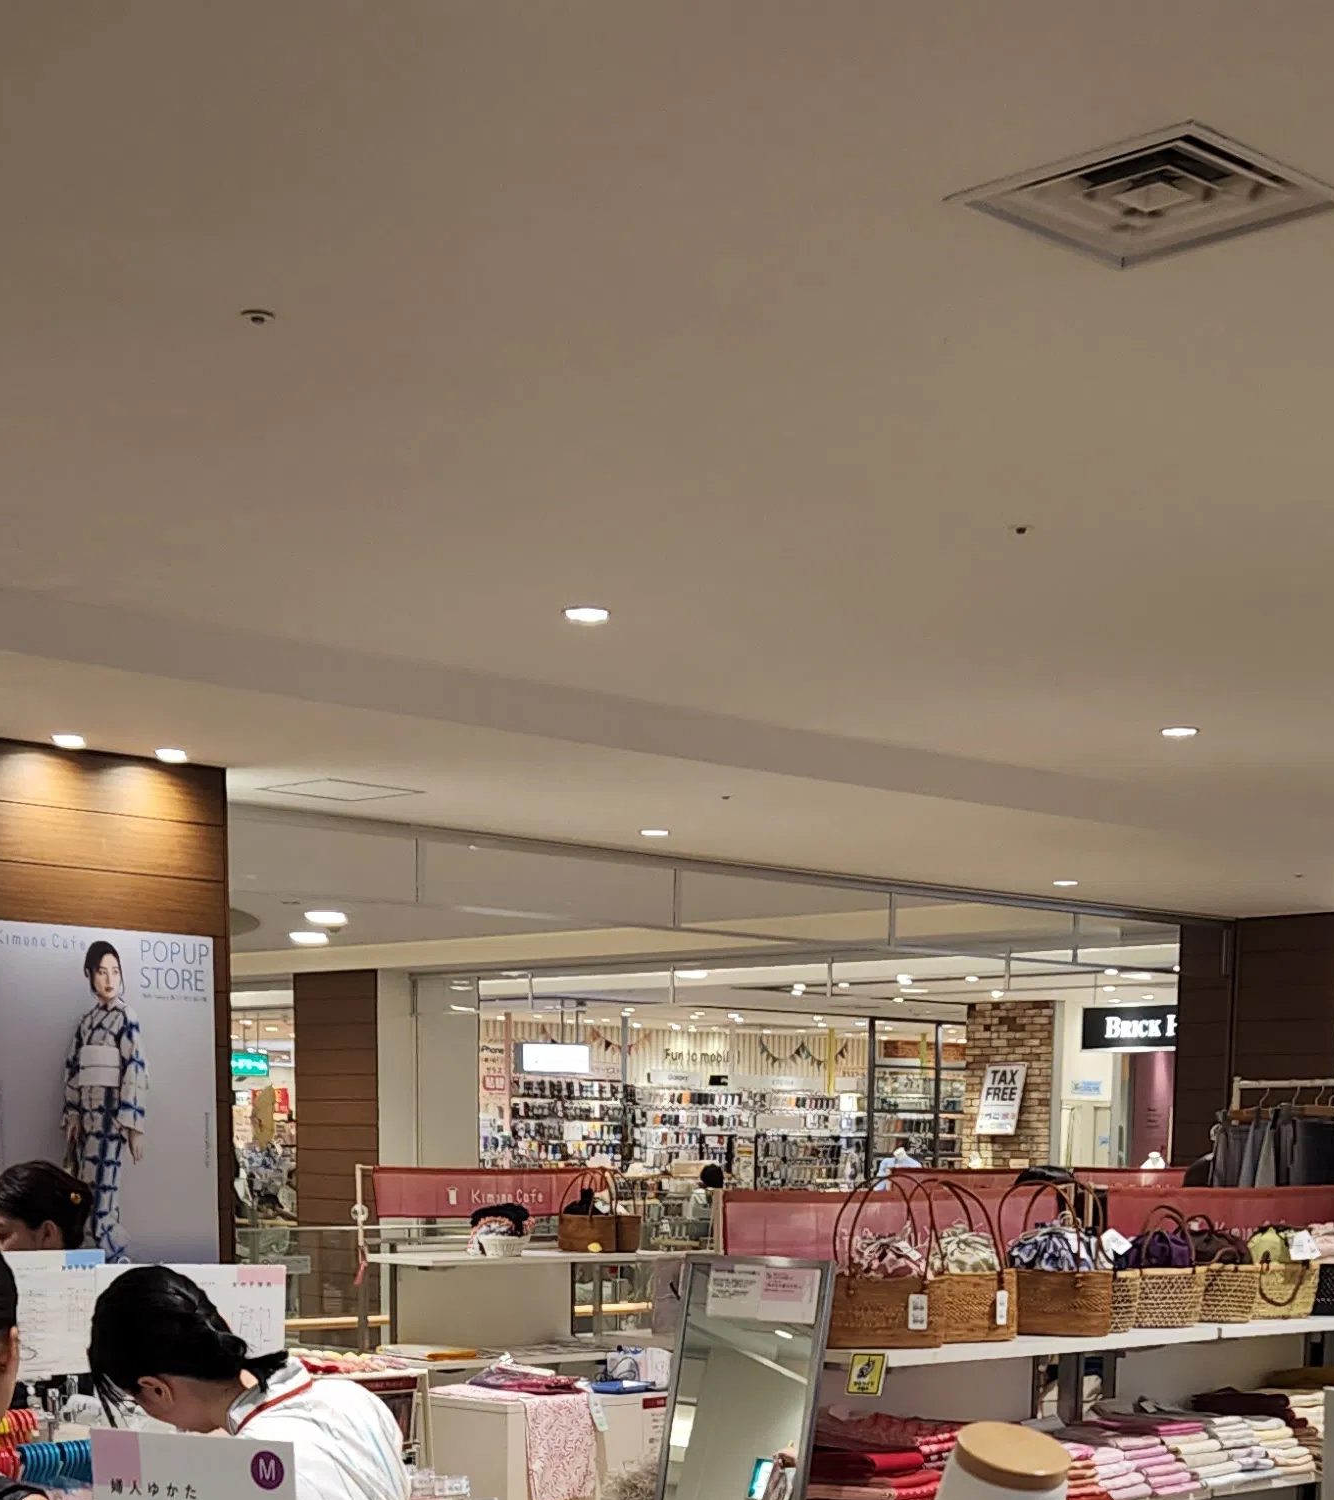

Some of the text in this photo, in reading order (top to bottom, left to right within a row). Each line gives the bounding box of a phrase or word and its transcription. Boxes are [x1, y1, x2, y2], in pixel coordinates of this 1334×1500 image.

[140, 939, 210, 966] POPUP
[140, 966, 206, 993] STORE
[1104, 1016, 1162, 1039] BRICK
[991, 1068, 1019, 1086] TAX
[985, 1086, 1018, 1102] FREE
[516, 1188, 544, 1204] Cafe
[258, 1457, 277, 1481] M
